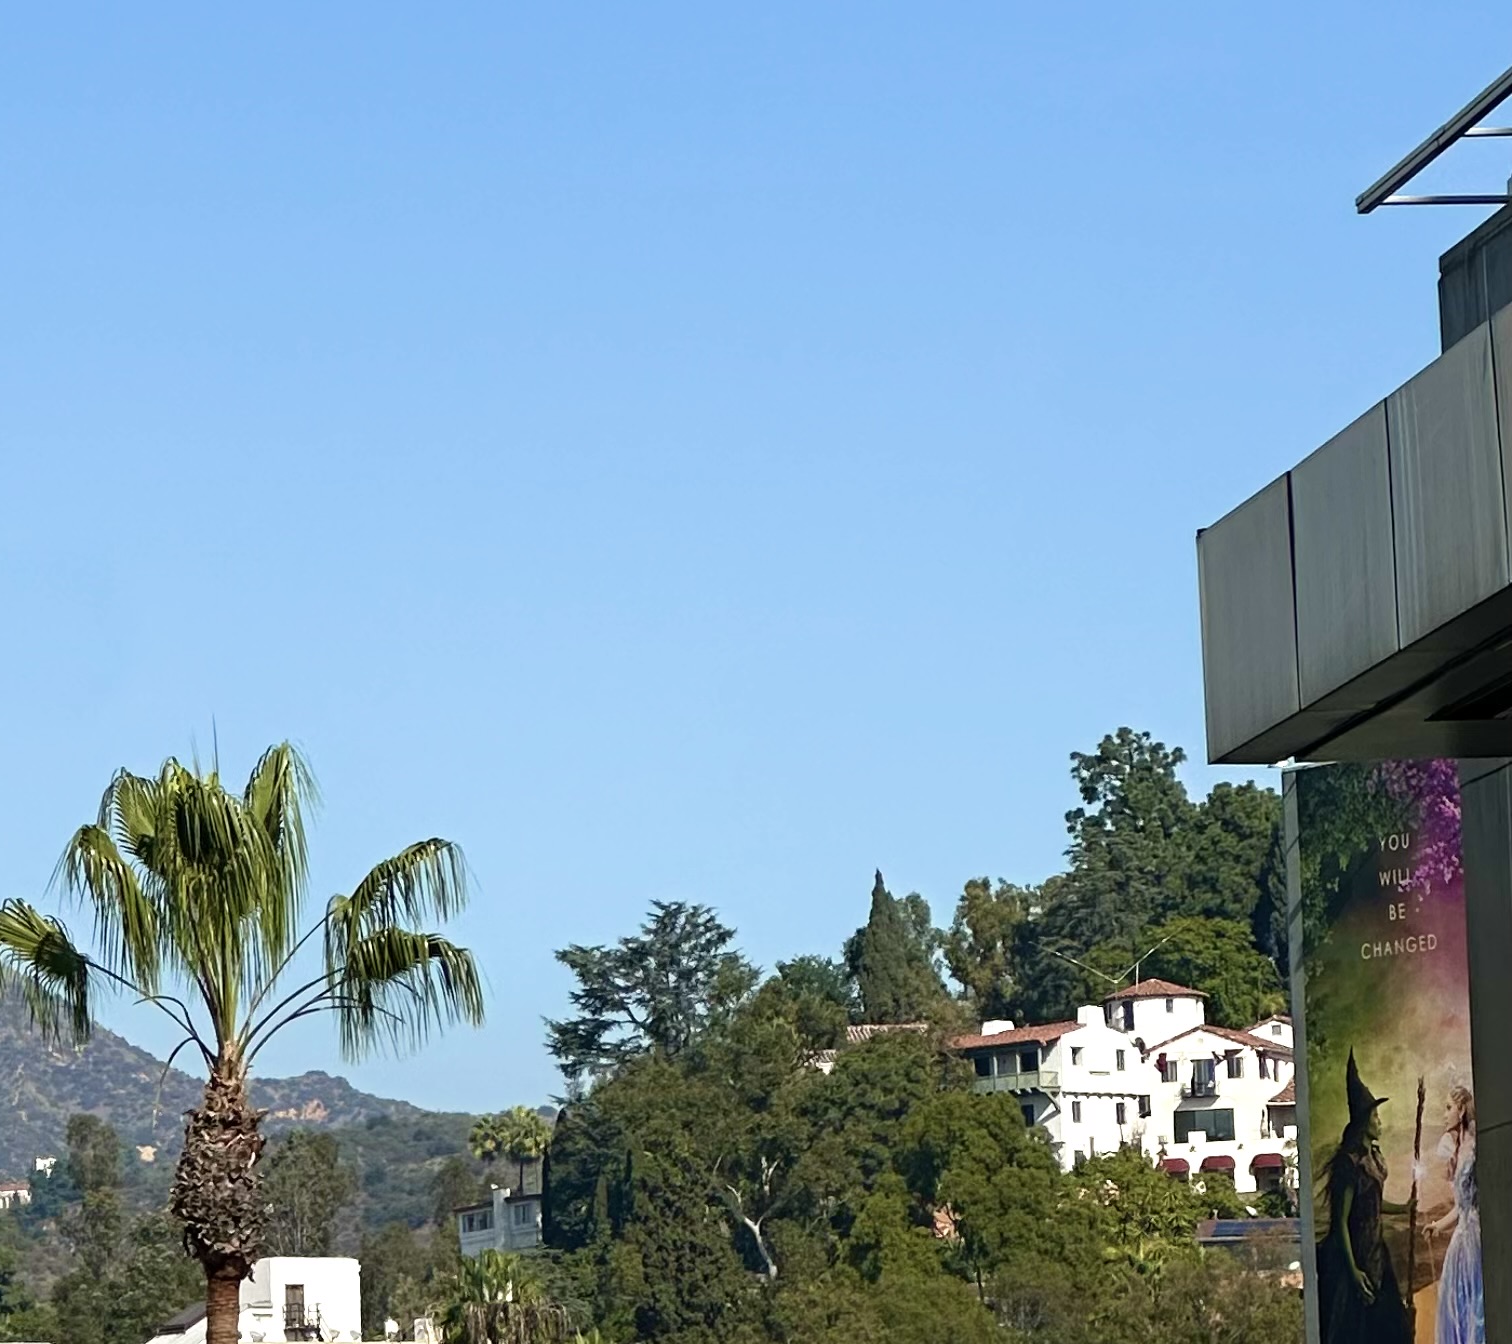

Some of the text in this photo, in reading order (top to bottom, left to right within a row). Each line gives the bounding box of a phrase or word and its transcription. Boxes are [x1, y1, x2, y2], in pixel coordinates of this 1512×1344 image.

[1379, 832, 1410, 852] YOU
[1379, 867, 1412, 887] WILL
[1389, 903, 1406, 920] BE
[1361, 933, 1438, 960] CHANGED
